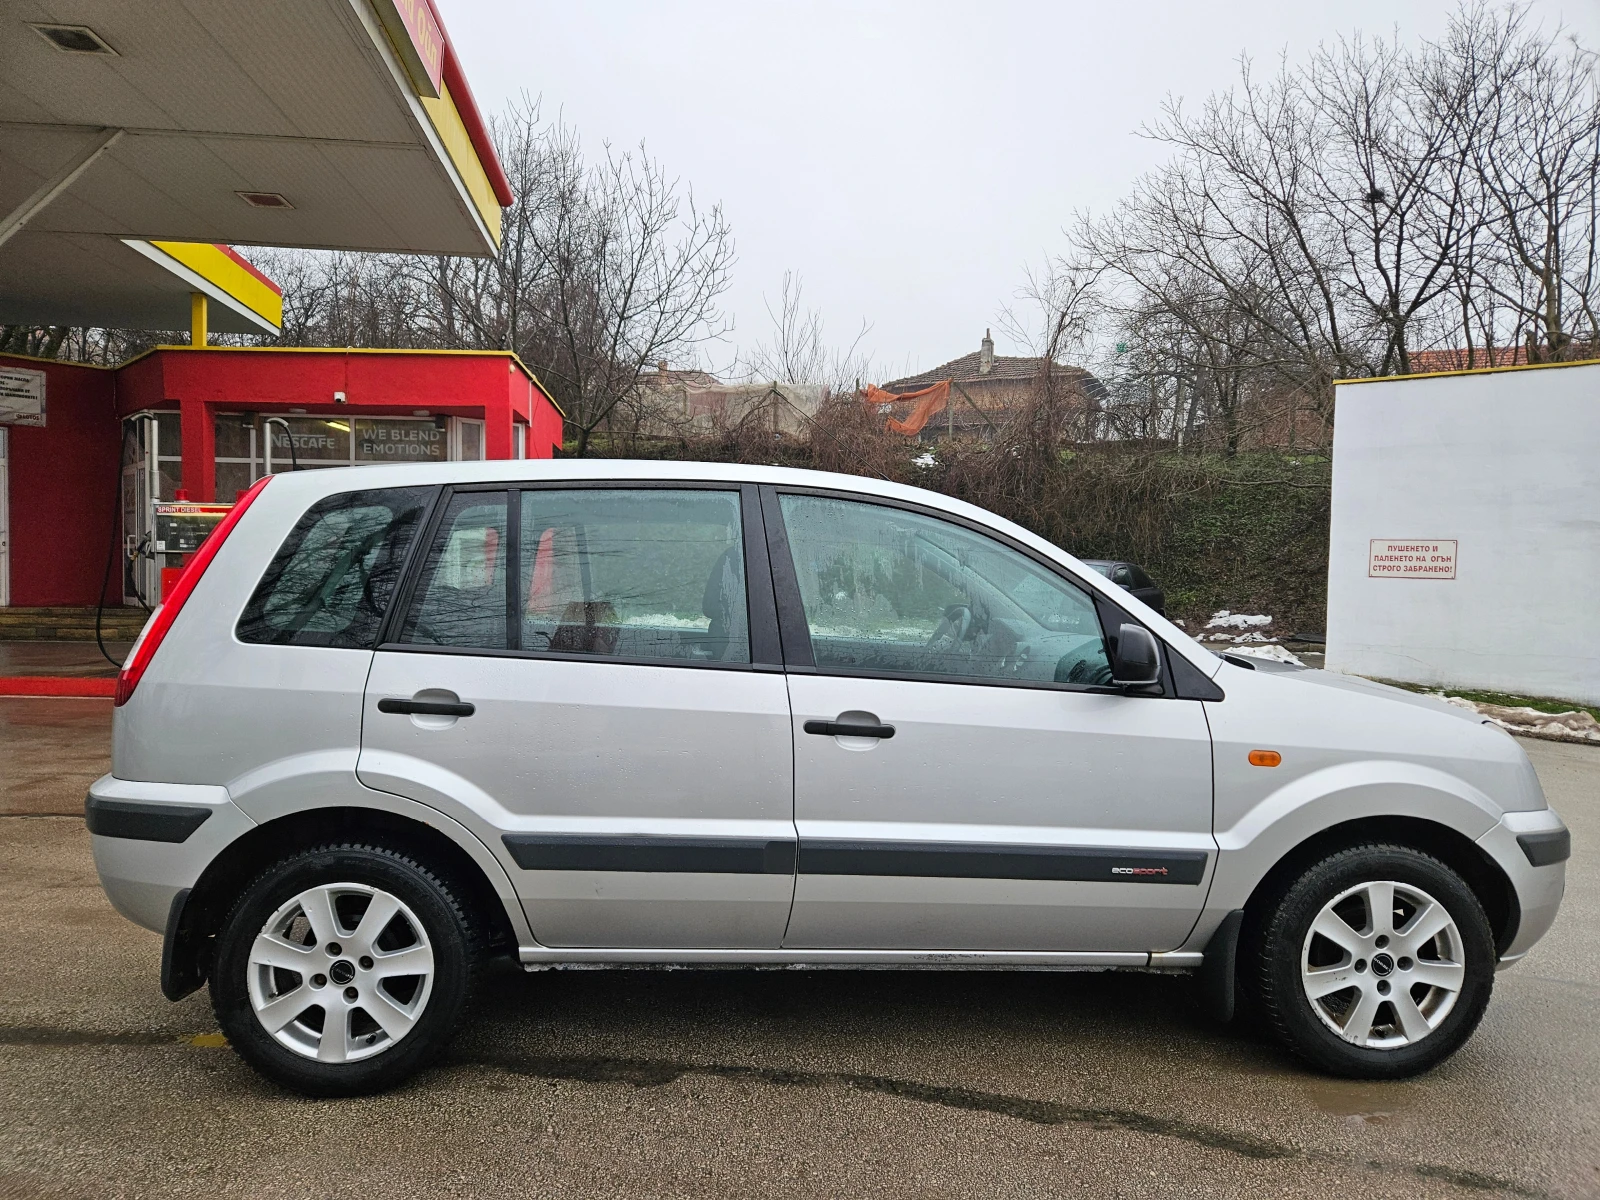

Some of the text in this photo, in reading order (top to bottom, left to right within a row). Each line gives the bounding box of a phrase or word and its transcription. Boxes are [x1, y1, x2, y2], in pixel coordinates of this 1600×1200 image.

[363, 429, 440, 441] WE BLEND
[363, 443, 440, 456] EMOTIONS
[1403, 565, 1453, 573] ЗАБРАНЕНО!
